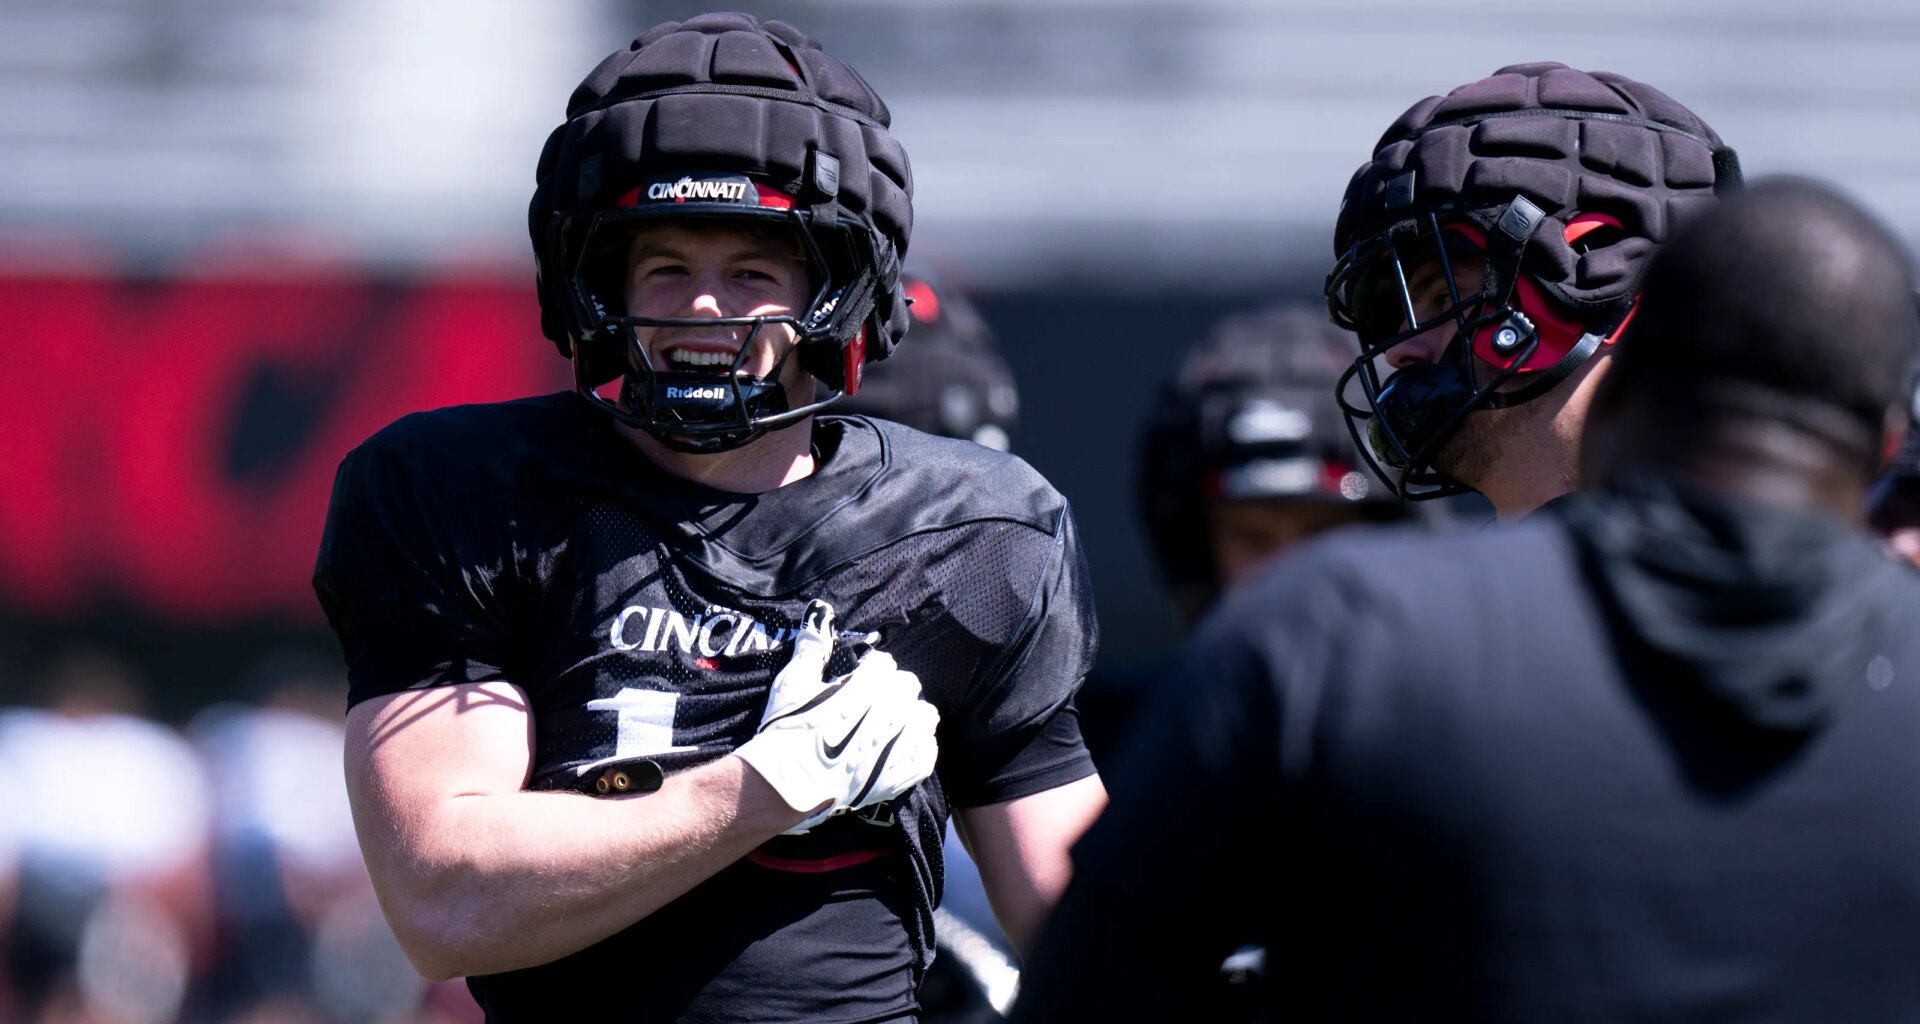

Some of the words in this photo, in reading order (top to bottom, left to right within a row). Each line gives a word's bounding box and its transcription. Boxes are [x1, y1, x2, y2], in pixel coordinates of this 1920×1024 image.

[648, 176, 746, 200] CINCINNATI
[667, 386, 724, 400] Riddell
[610, 605, 881, 658] CINCIN
